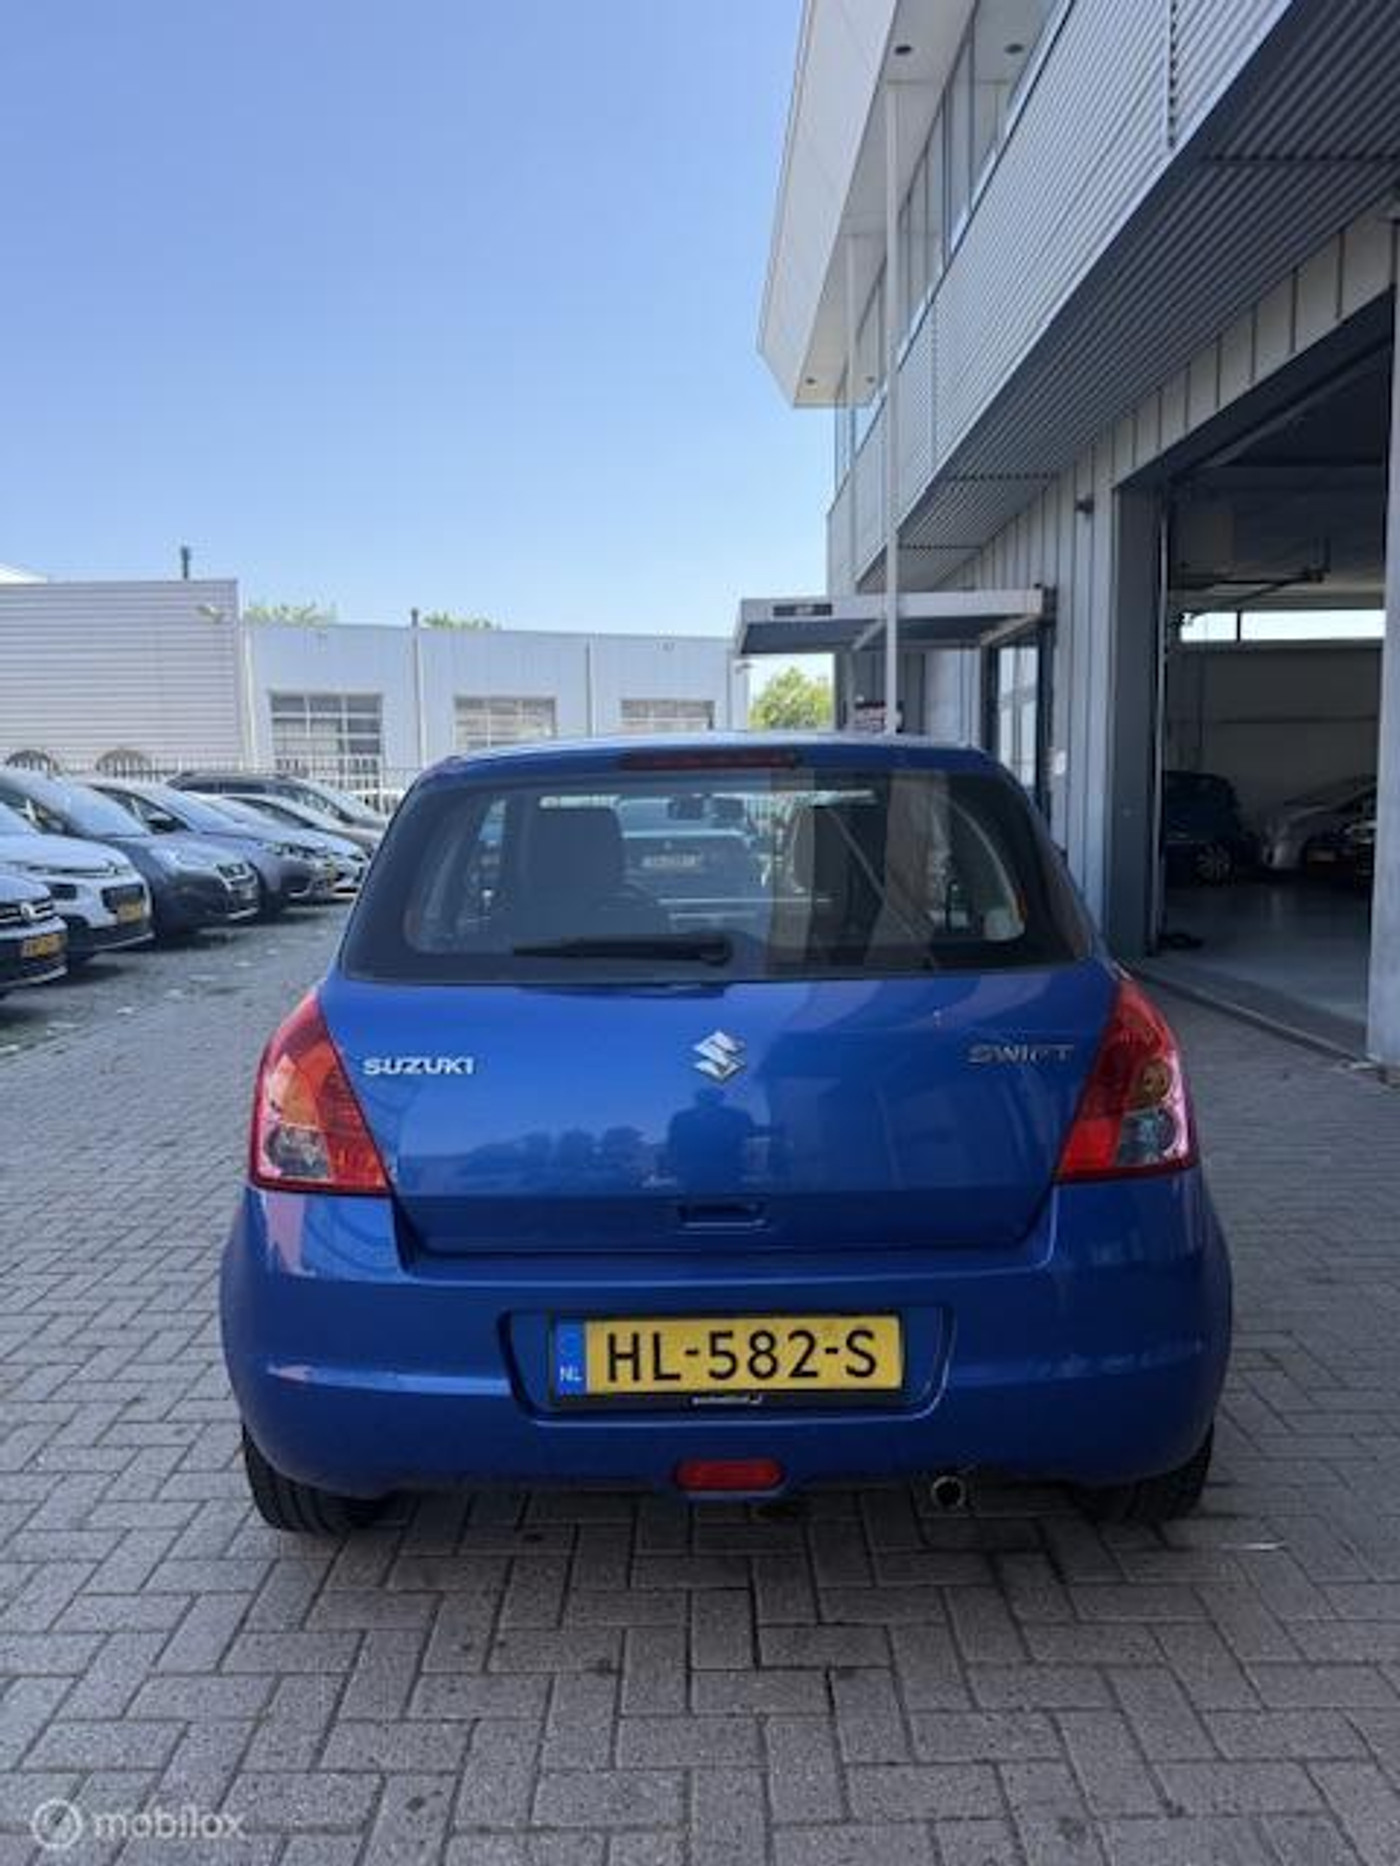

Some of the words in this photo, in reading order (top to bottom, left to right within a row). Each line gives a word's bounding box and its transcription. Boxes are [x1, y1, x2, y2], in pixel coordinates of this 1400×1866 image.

[362, 1057, 475, 1076] SUZUKI
[606, 1329, 877, 1383] HL-582-S
[559, 1366, 583, 1382] NL
